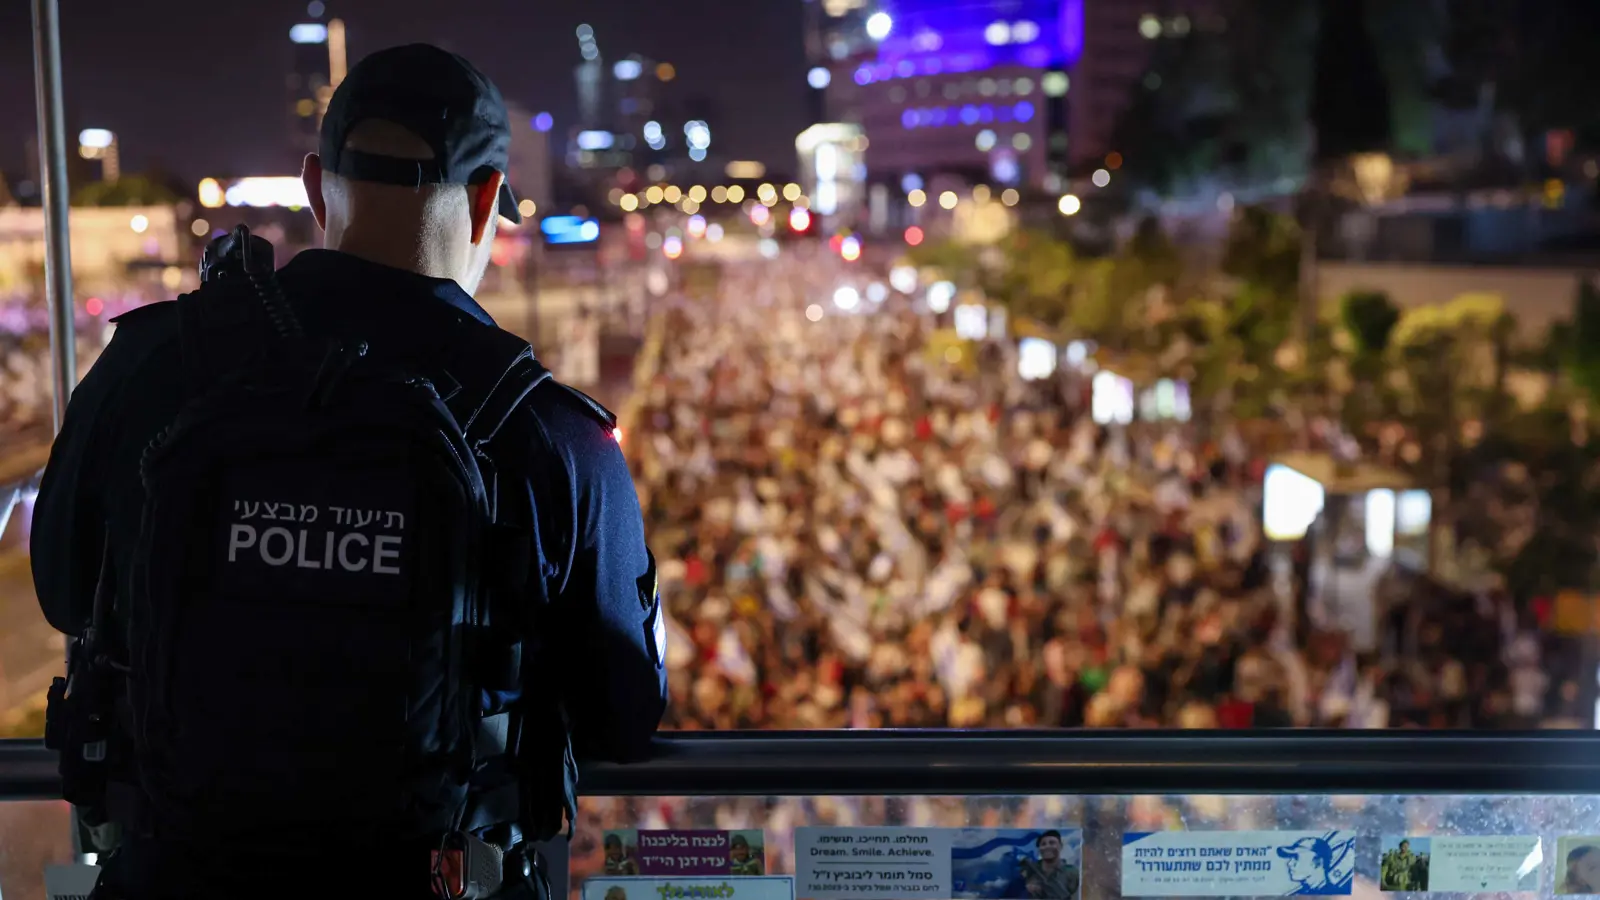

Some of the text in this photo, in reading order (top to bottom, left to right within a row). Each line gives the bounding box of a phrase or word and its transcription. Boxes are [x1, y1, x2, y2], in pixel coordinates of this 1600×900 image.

[234, 499, 405, 529] תיעוד מבצעי
[228, 523, 402, 574] POLICE
[641, 834, 726, 847] לנצח בליבנו!
[816, 835, 928, 844] תחלמו. תחייכו. תגשימו.
[810, 847, 935, 857] Dream. Smile. Achieve.
[1134, 846, 1164, 857] להיות
[1167, 847, 1196, 857] רוצים
[1199, 847, 1232, 857] שאתם
[677, 855, 699, 869] דנן
[702, 855, 726, 867] עדי
[1206, 859, 1230, 872] לכם
[1234, 860, 1271, 873] ממתין
[833, 870, 873, 882] ליבוביץ
[876, 871, 905, 880] תומר
[907, 870, 933, 880] סמל
